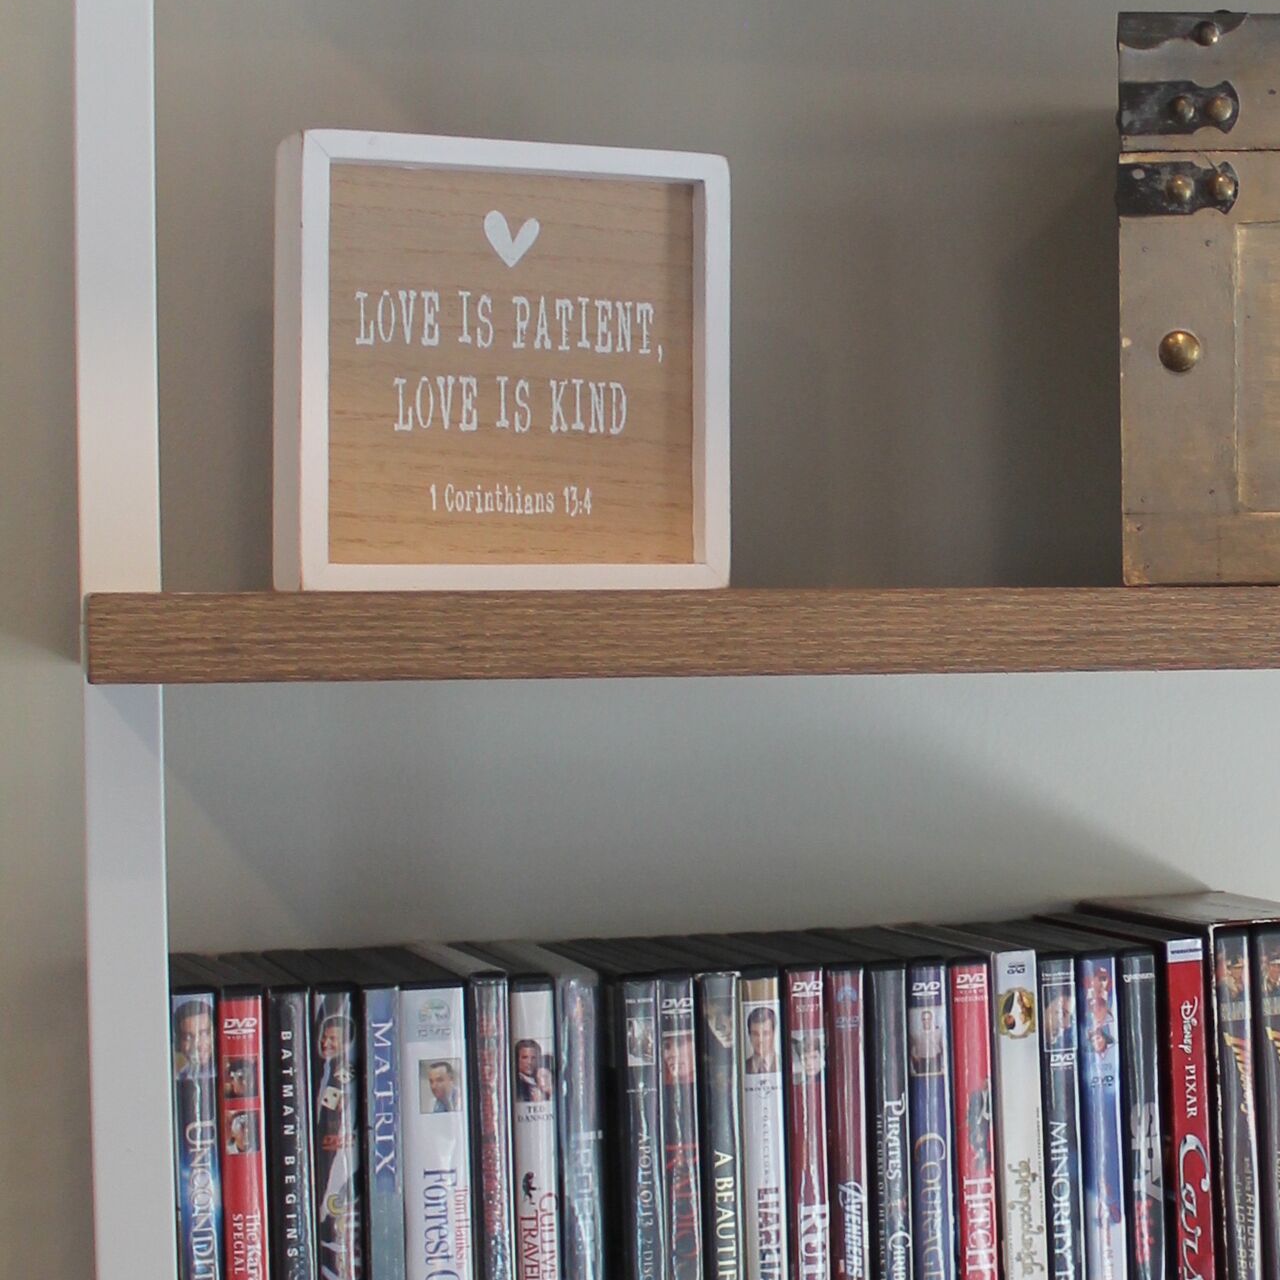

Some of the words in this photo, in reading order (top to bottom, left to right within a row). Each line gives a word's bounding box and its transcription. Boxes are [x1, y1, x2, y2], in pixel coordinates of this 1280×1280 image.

[355, 290, 440, 347] LOVE
[458, 290, 494, 349] IS
[512, 295, 665, 363] PATIENT,
[393, 375, 478, 433] LOVE
[496, 375, 531, 433] IS
[549, 378, 629, 436] KIND
[429, 484, 438, 512] 1
[445, 484, 555, 515] Corinthians
[562, 485, 593, 517] 13:4
[662, 998, 691, 1009] DVD
[792, 981, 822, 992] DVD
[912, 981, 941, 991] DVD
[956, 973, 985, 984] DVD
[224, 1018, 257, 1029] DVD
[1178, 996, 1199, 1054] Disney
[281, 1030, 296, 1136] BATMAN
[1050, 1053, 1076, 1063] DVD
[370, 1018, 396, 1176] MATRIX
[1184, 1064, 1198, 1119] PIXAR
[713, 1150, 734, 1168] A
[884, 1093, 907, 1180] PIRATES
[284, 1155, 299, 1259] BEGINS
[423, 1167, 458, 1266] Forrest
[453, 1186, 469, 1215] Tom
[1049, 1121, 1073, 1263] MINORITY
[232, 1213, 246, 1274] SPECIAL
[246, 1211, 262, 1241] The
[455, 1217, 470, 1260] Hanks
[838, 1181, 866, 1279] AVENGERS
[963, 1175, 998, 1276] HITCH
[1245, 1193, 1257, 1271] RAIDERS
